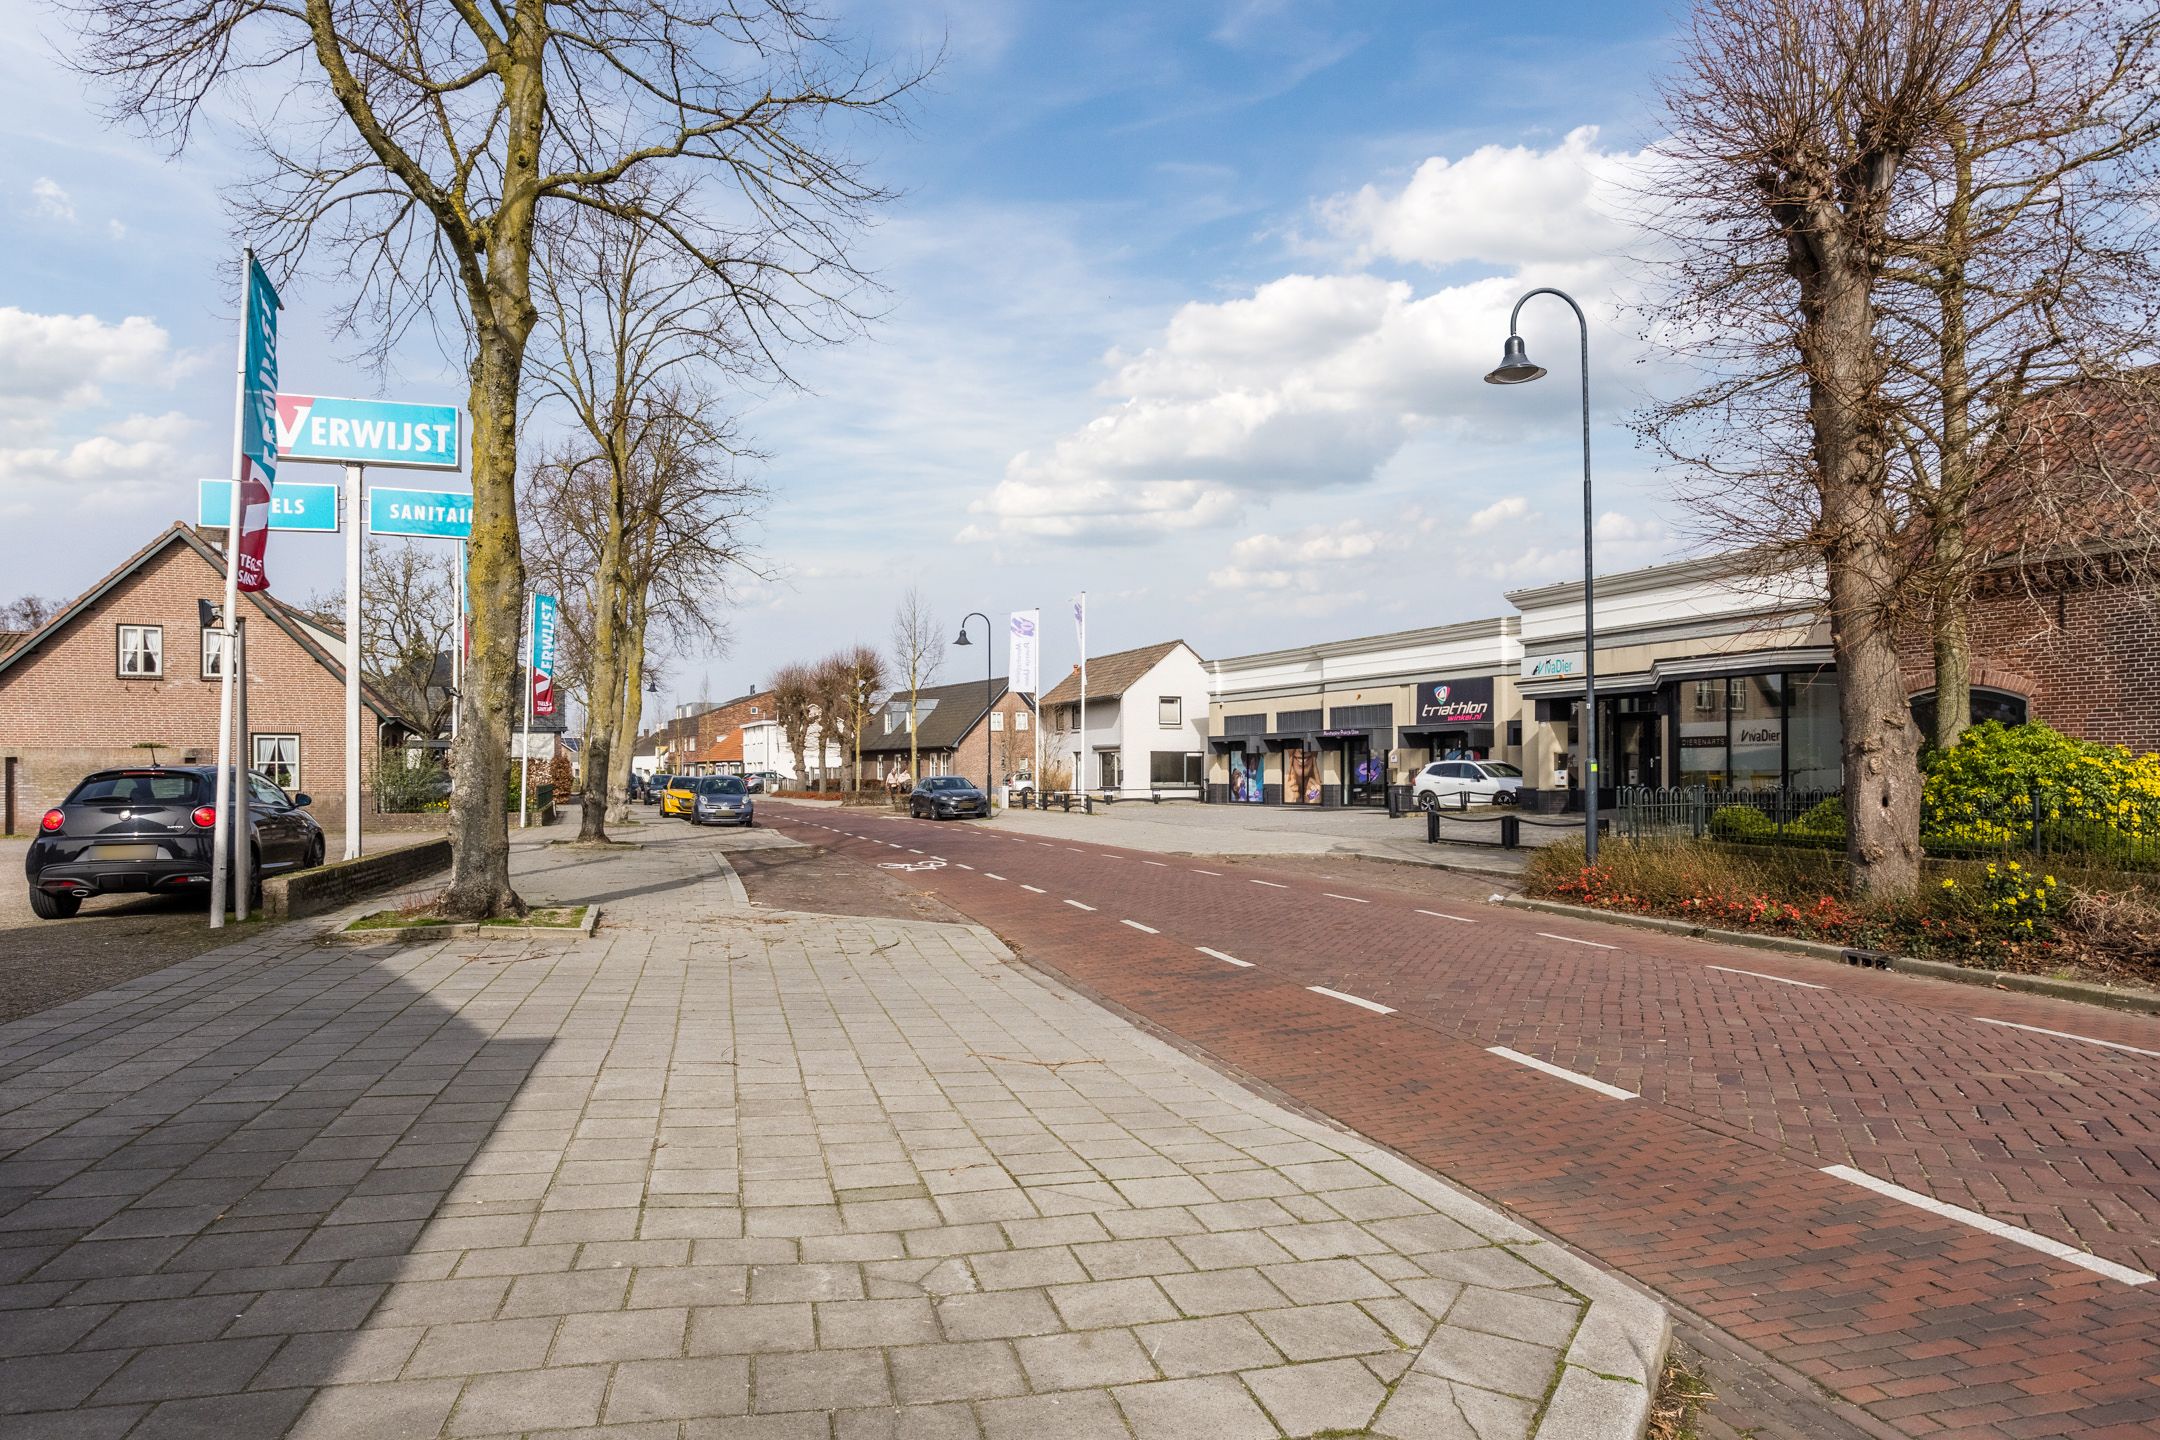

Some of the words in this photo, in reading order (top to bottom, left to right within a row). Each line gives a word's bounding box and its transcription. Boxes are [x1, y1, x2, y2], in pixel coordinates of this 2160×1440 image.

[275, 406, 450, 452] VERWIJST
[271, 498, 305, 514] ELS
[535, 602, 554, 695] VERWIJST
[1422, 701, 1487, 717] triathlon
[1447, 712, 1482, 721] winkel.nl
[1741, 728, 1780, 742] VivaDier
